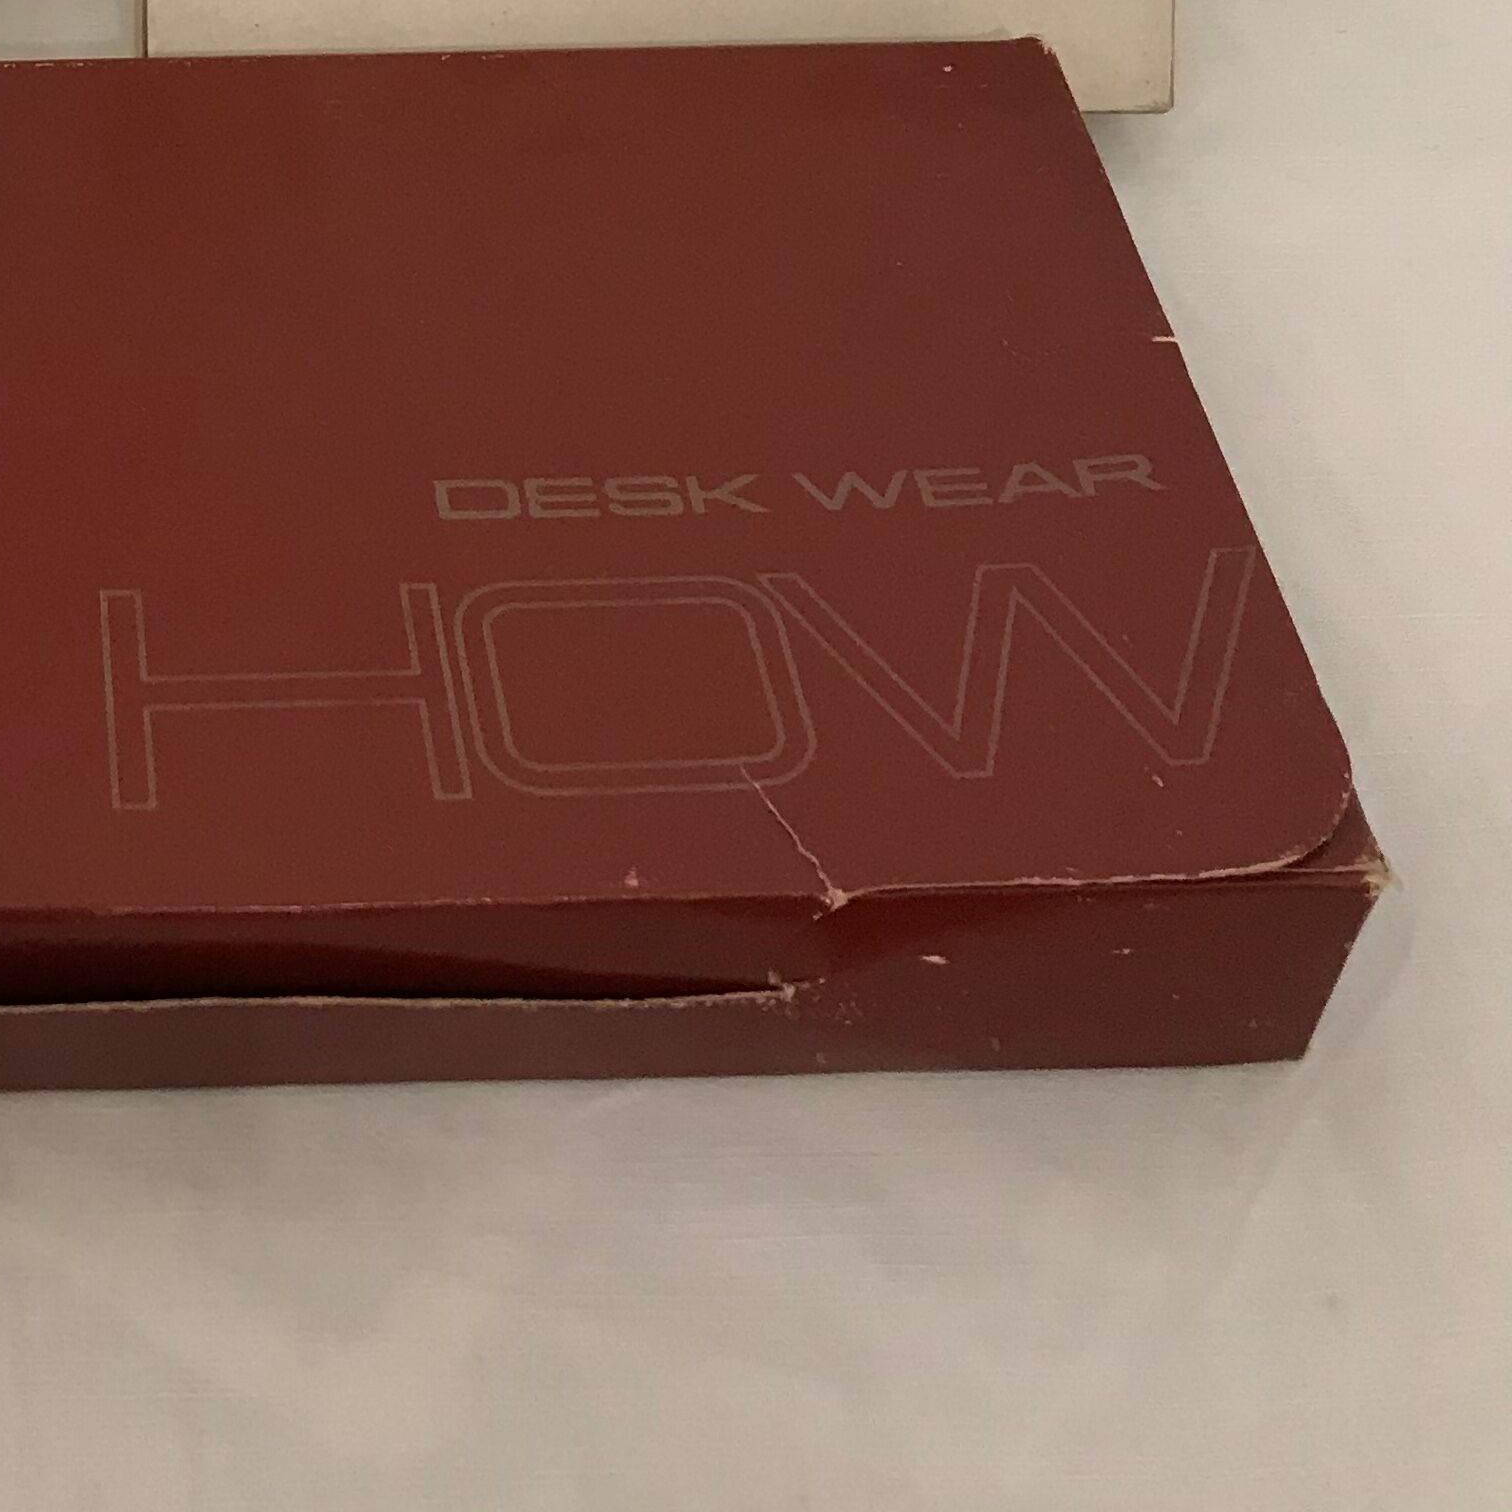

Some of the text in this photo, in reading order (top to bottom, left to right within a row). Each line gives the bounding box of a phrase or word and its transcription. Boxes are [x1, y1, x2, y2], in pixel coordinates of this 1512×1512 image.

[432, 453, 1167, 521] DESK WEAR
[99, 546, 1256, 810] HOW
